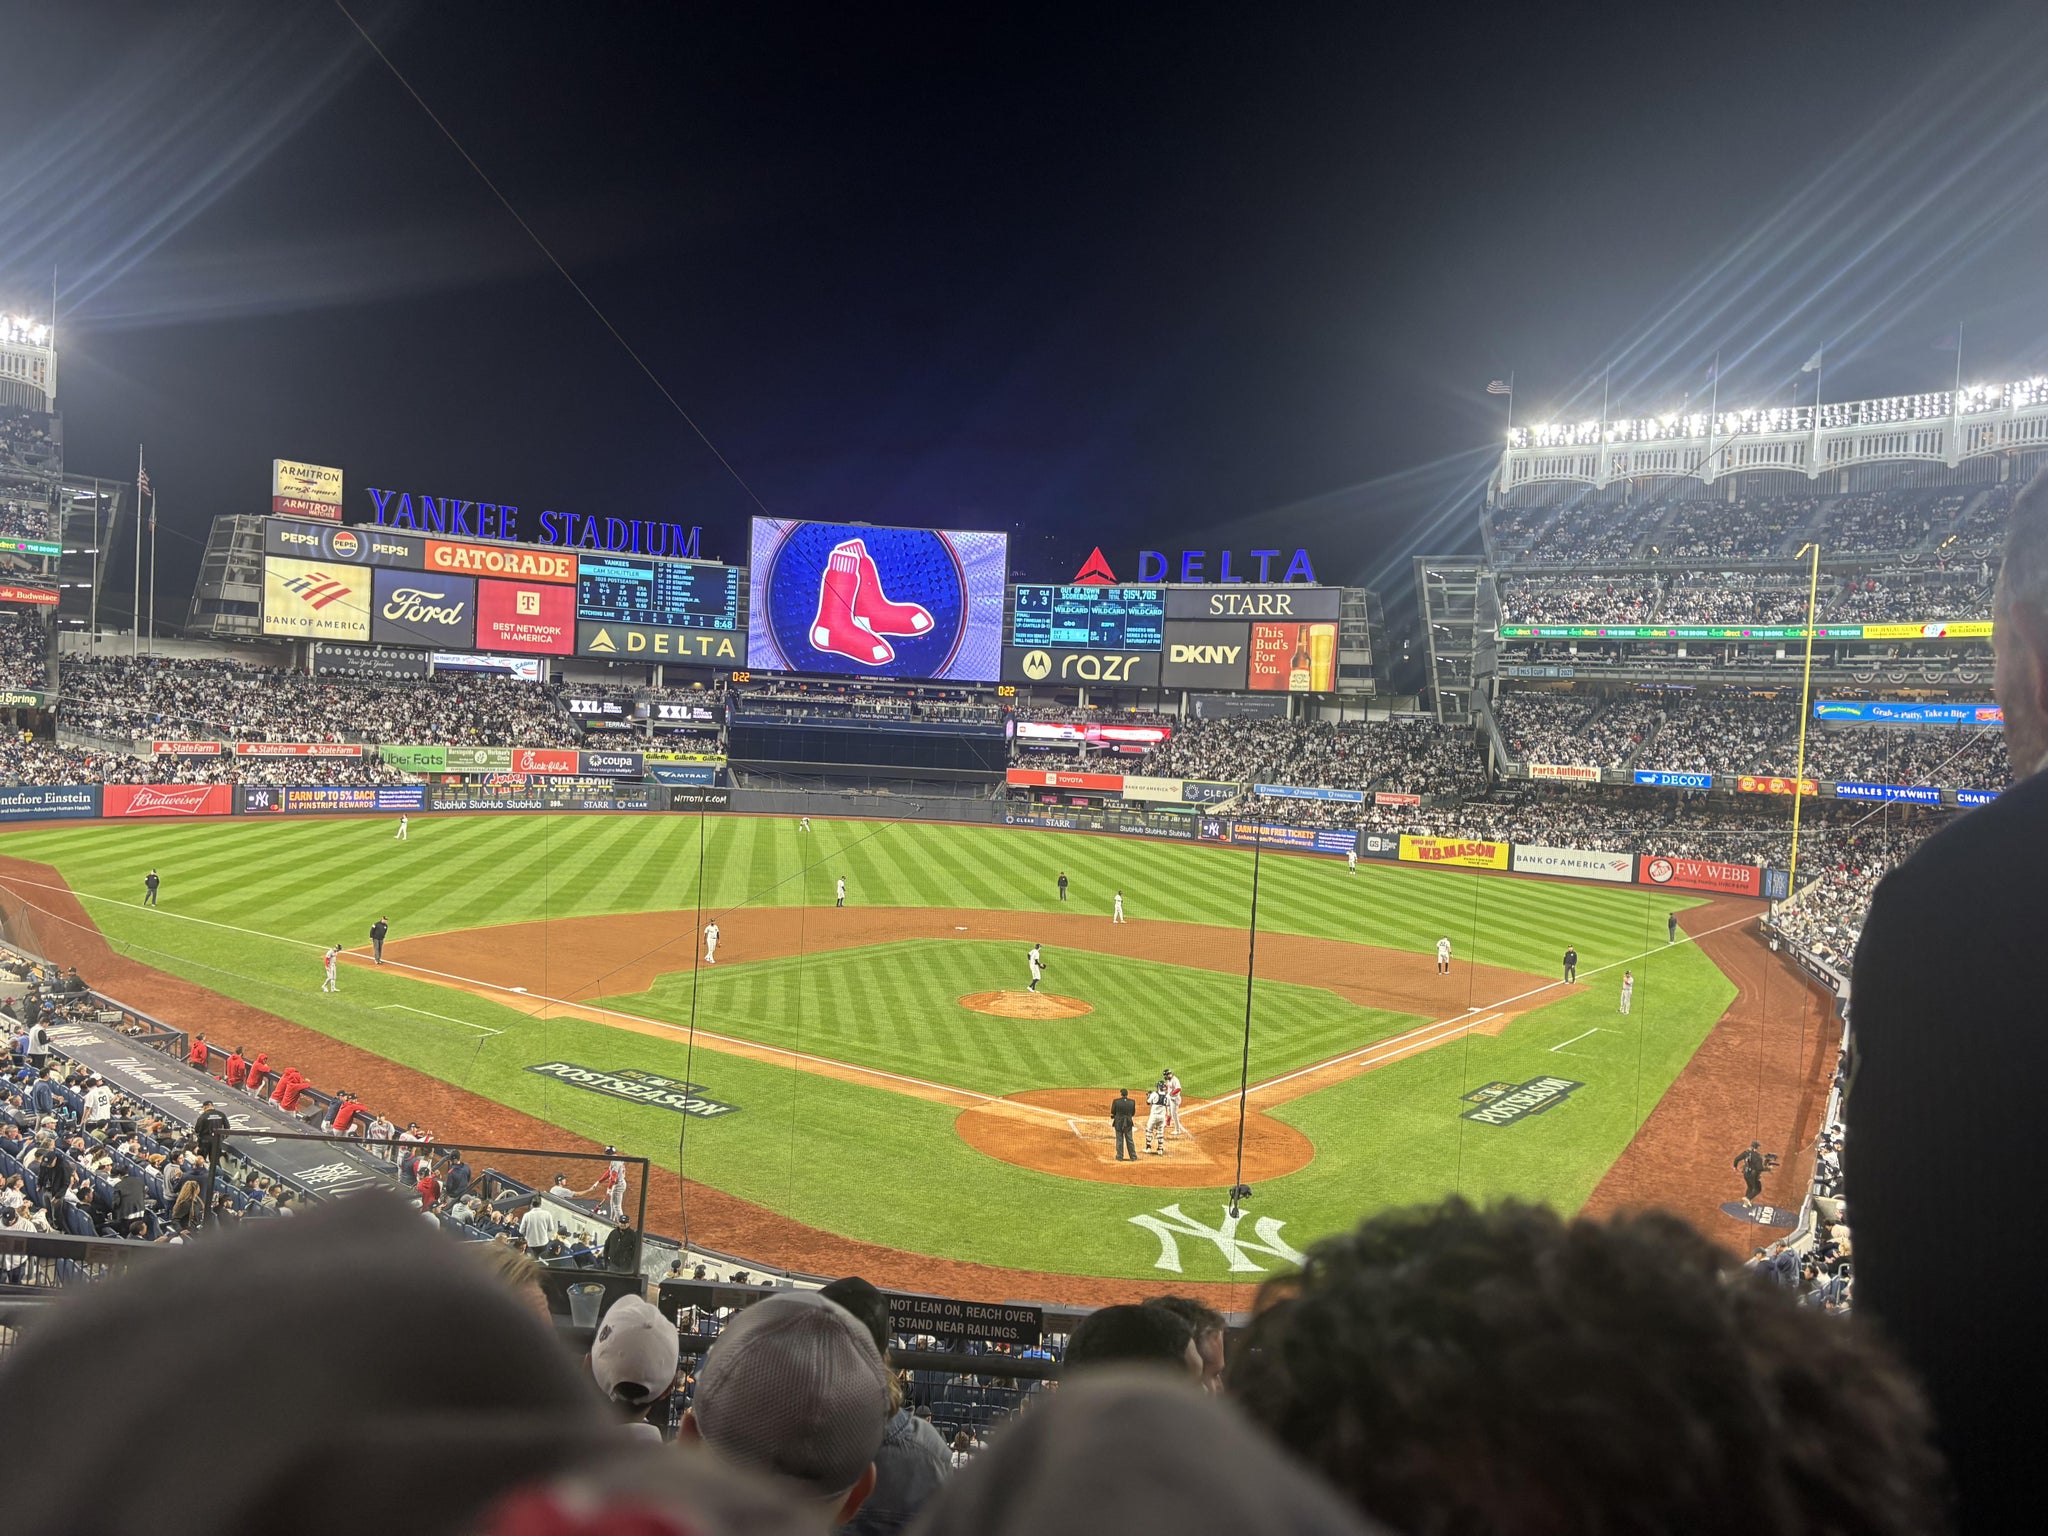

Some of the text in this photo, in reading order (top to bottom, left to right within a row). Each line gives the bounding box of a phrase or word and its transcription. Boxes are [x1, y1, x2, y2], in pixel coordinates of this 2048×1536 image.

[281, 466, 339, 481] ARMITRON
[283, 500, 336, 513] ARMITRON
[366, 488, 703, 559] YANKEE STADIUM
[281, 532, 319, 546] PEPSI
[335, 540, 357, 549] PEPSI
[372, 543, 409, 557] PEPSI
[434, 546, 570, 577] GATORADE
[1138, 549, 1318, 583] DELTA
[16, 591, 58, 602] Budweiser
[1021, 596, 1048, 605] 6 3
[383, 588, 465, 625] Ford
[1209, 594, 1294, 615] STARR
[266, 615, 366, 631] BANK OF AMERICA
[493, 622, 561, 635] BEST NETWORK
[714, 620, 733, 629] 8:48
[500, 633, 553, 644] IN AMERICA
[1255, 626, 1284, 638] This
[627, 631, 736, 658] DELTA
[1255, 639, 1289, 650] Bud's
[1169, 644, 1241, 665] DKNY
[1254, 651, 1276, 662] For
[1062, 654, 1141, 682] razr
[1254, 663, 1280, 674] You.
[732, 671, 750, 683] 0:22
[998, 686, 1016, 697] 0:22
[5, 692, 37, 706] Spring
[570, 700, 601, 713] XXL
[658, 705, 692, 719] XXL
[1872, 707, 1892, 717] Grab
[1901, 711, 1922, 720] Patty,
[1924, 709, 1942, 718] Take
[382, 752, 443, 765] Uber Eats
[602, 757, 633, 767] coupa
[1532, 767, 1597, 778] Parts Authority
[1059, 776, 1083, 784] TOYOTA
[1662, 775, 1705, 786] DECOY
[44, 792, 91, 803] Einstein
[134, 792, 203, 807] Budweiser
[289, 791, 312, 801] EARN
[314, 790, 326, 801] UP
[327, 790, 338, 800] TO
[340, 790, 353, 800] 5%
[354, 790, 376, 800] BACK
[1204, 789, 1234, 798] CLEAR
[1836, 786, 1939, 800] CHARLES TYRWHITT
[289, 801, 338, 810] IN PINSTRIPE
[433, 800, 542, 810] StubHub StubHub StubHub
[584, 801, 609, 809] STARR
[1046, 819, 1070, 828] STARR
[1120, 825, 1192, 838] StubHub StubHub StubHub
[1235, 824, 1287, 837] EARN FREE
[1517, 854, 1606, 870] BANK OF AMERICA
[1676, 862, 1750, 882] F.W. WEBB
[534, 1063, 730, 1116] POSTSEASON
[98, 1095, 108, 1107] 99
[1469, 1077, 1574, 1124] POSTSEASON
[312, 1164, 348, 1182] YORK
[327, 1162, 362, 1177] NEW
[293, 1172, 322, 1185] LIFE
[890, 1299, 1036, 1325] NOT LEAN ON, REACH OVER,
[898, 1317, 1020, 1339] STAND NEAR RAILINGS.
